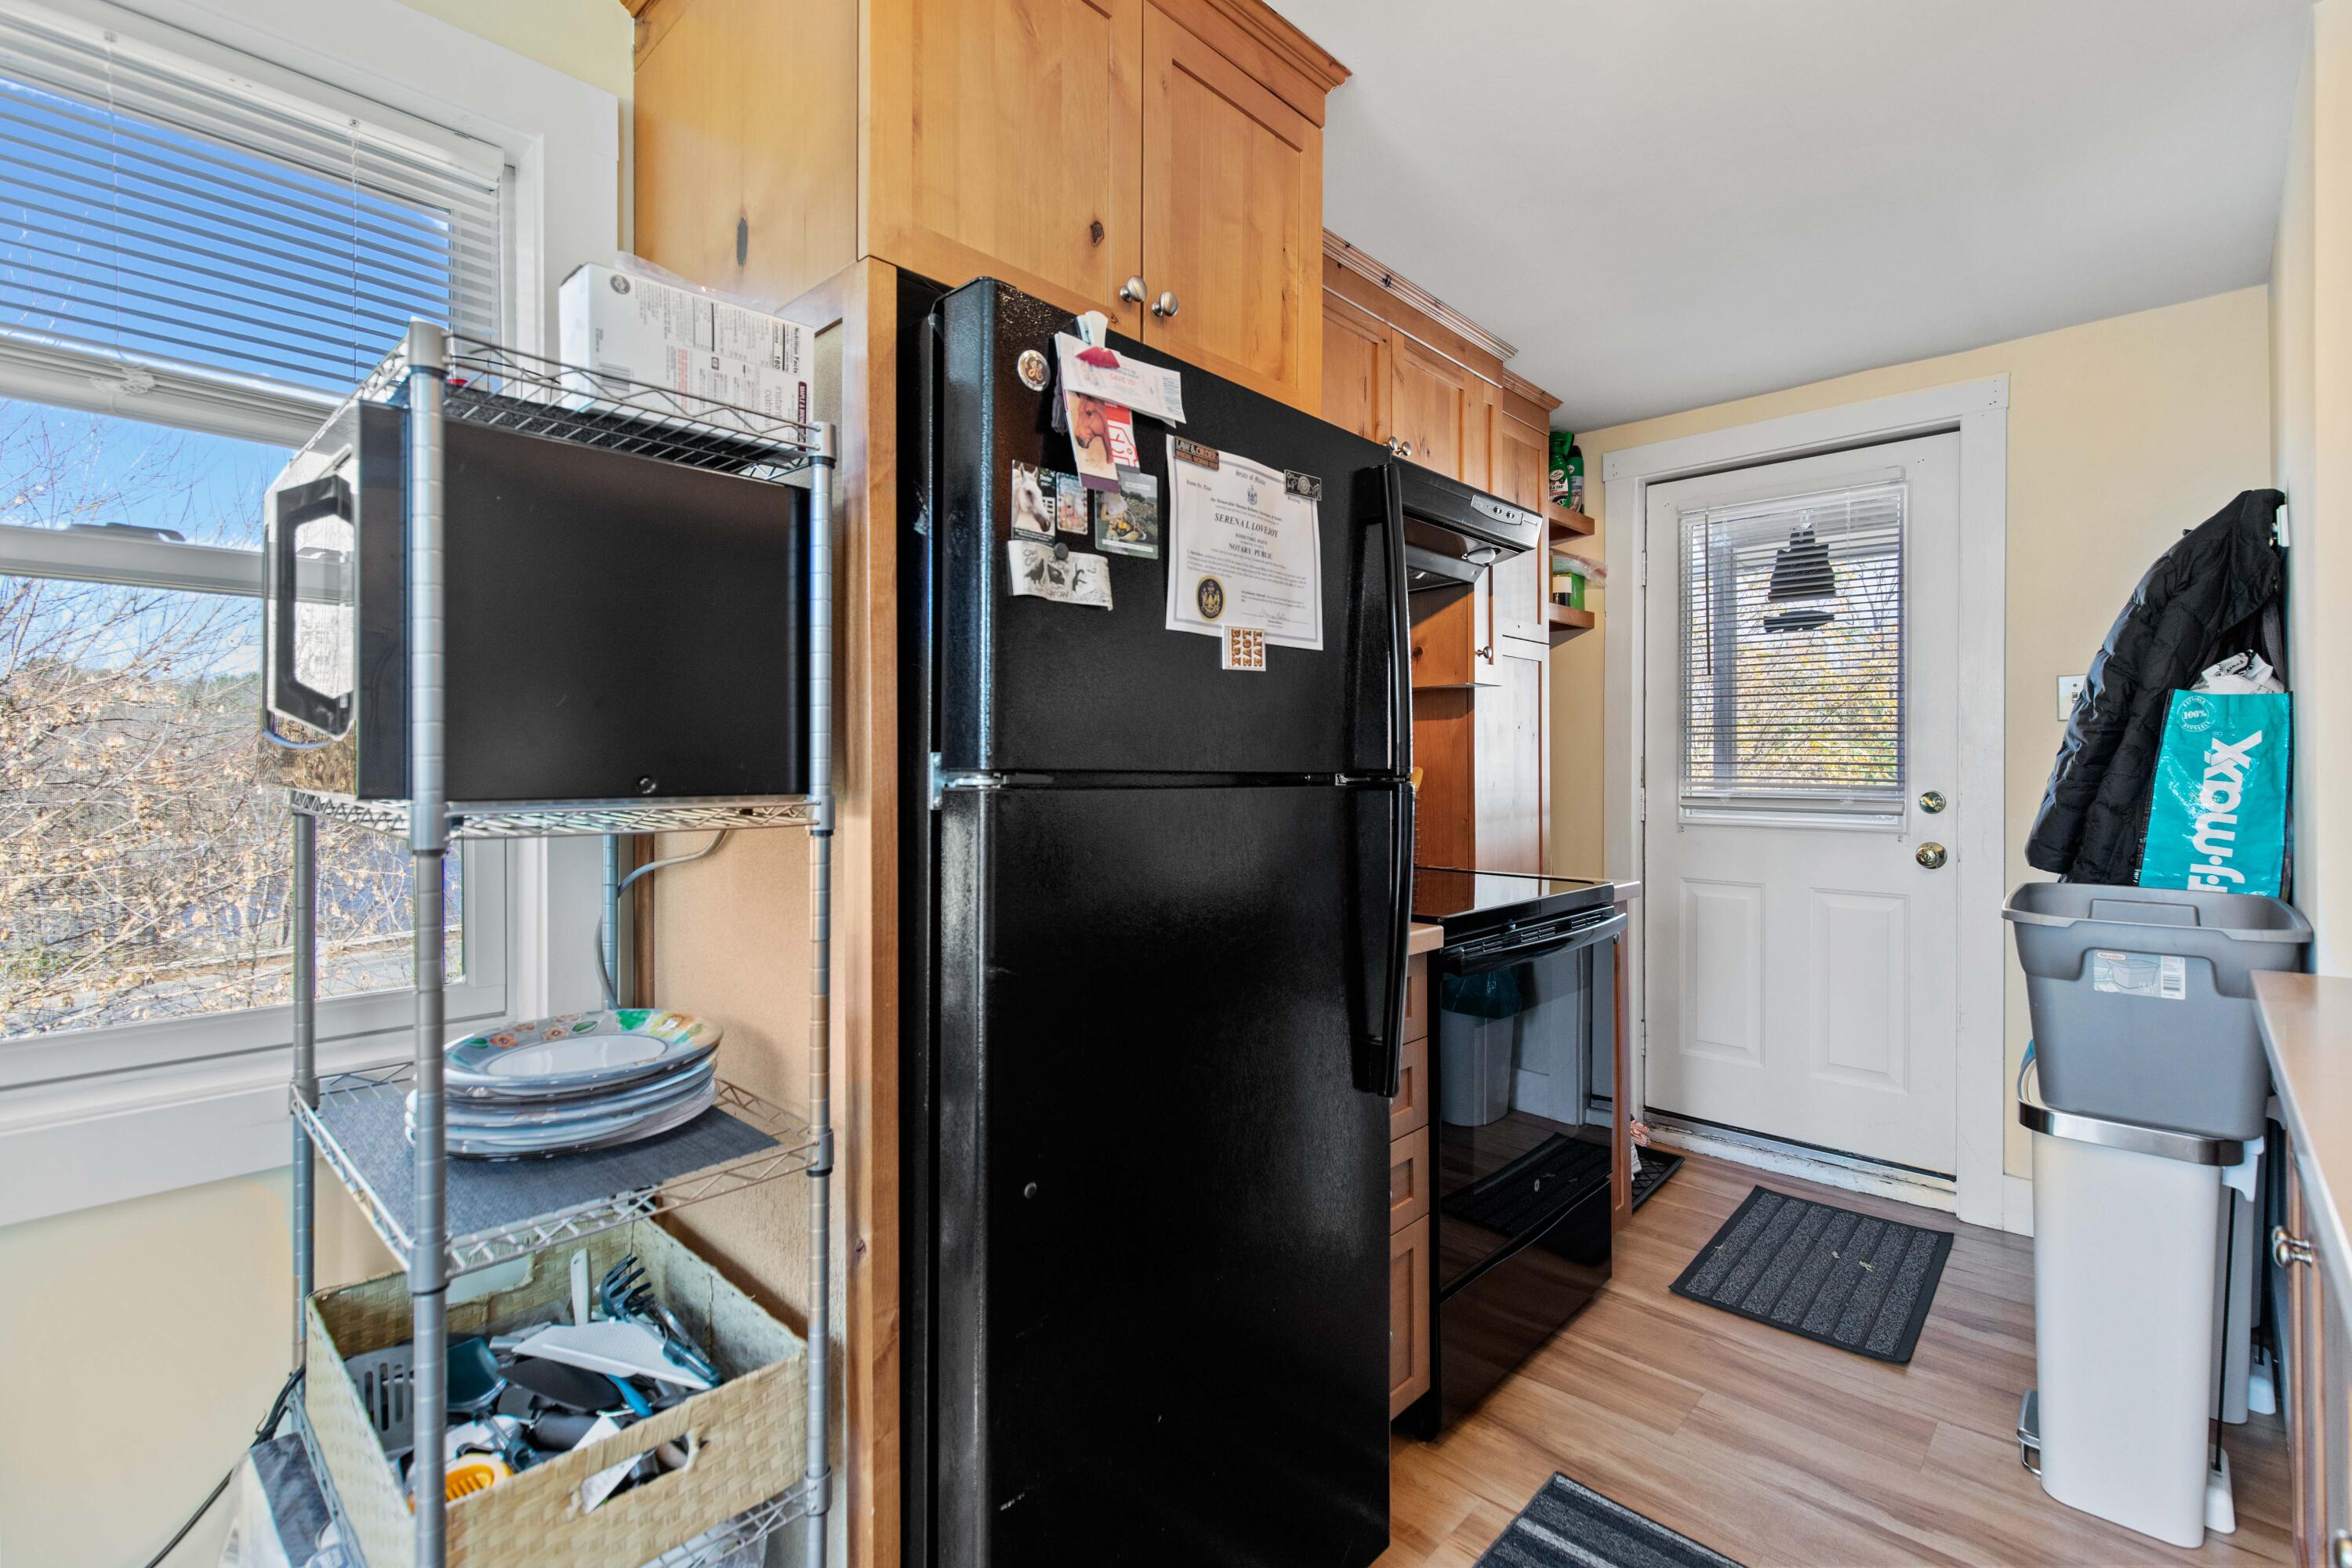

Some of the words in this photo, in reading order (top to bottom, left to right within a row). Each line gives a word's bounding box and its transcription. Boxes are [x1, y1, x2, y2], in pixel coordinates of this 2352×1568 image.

[1176, 439, 1190, 452] LAW
[1214, 513, 1244, 528] SERENA
[1251, 522, 1279, 538] LOVEJOY
[1229, 543, 1251, 554] NOTARY
[1254, 550, 1273, 560] PUBLIC
[1231, 628, 1241, 666] BARK
[1243, 630, 1252, 666] LOVE
[1253, 630, 1262, 667] LIVE
[2183, 710, 2208, 720] 100%
